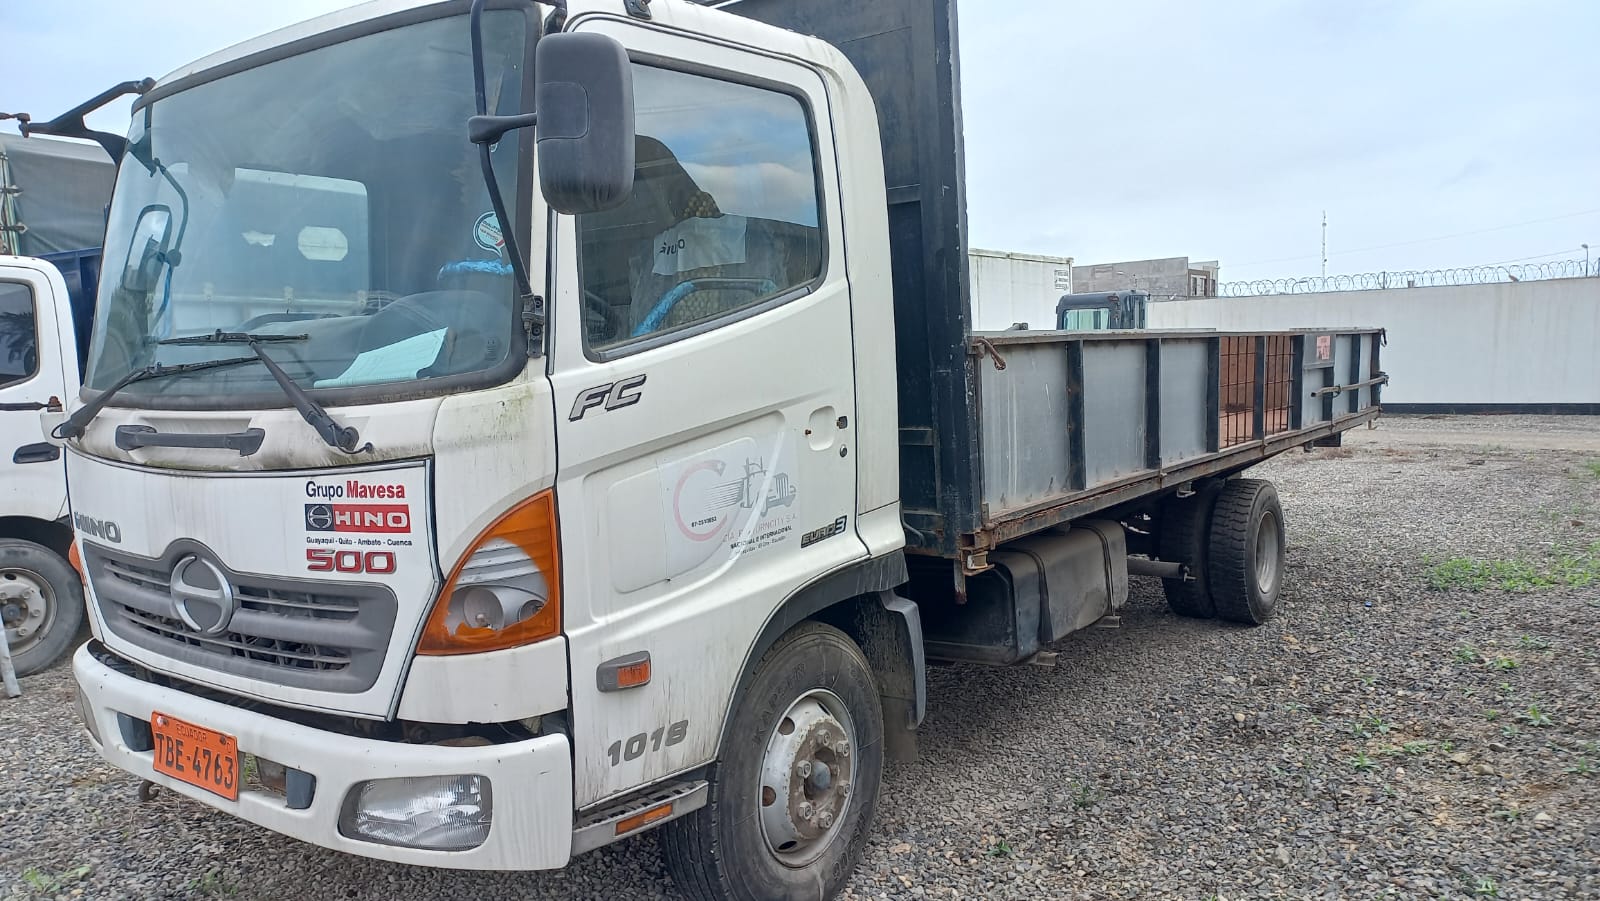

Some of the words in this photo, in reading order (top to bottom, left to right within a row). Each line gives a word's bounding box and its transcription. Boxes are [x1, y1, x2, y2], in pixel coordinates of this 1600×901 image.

[568, 373, 647, 422] FC
[305, 480, 344, 501] Grupo
[346, 480, 406, 499] Mavesa
[73, 511, 122, 544] HINO
[334, 510, 408, 528] HINO
[306, 536, 335, 545] Guayaquil
[338, 537, 353, 545] Quito
[306, 548, 398, 575] 500
[175, 722, 207, 742] ECUADOR
[607, 719, 689, 767] 1018
[155, 732, 233, 789] TBE-4763
